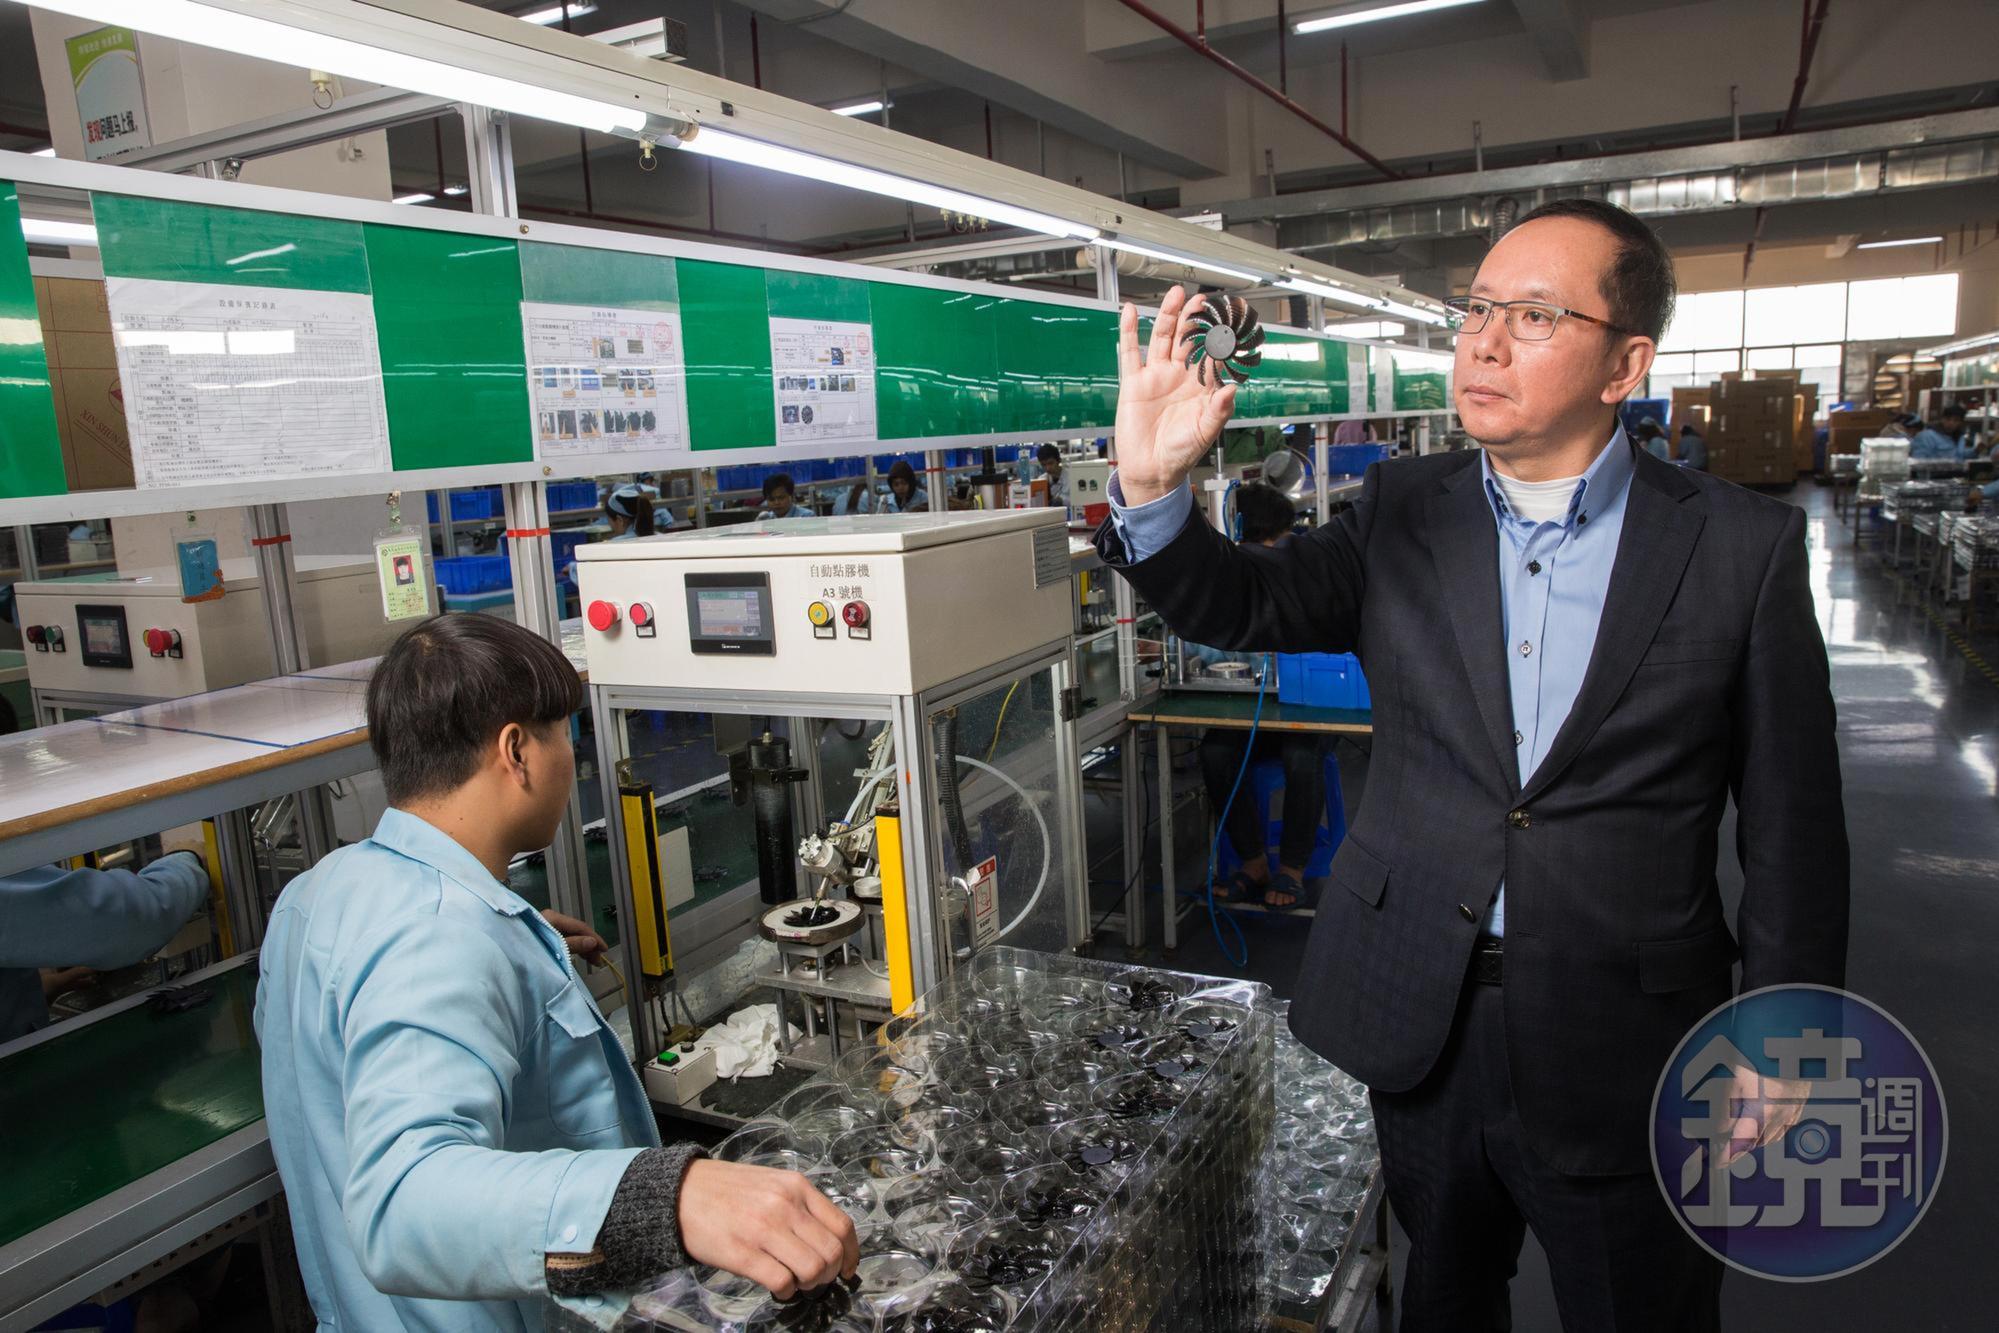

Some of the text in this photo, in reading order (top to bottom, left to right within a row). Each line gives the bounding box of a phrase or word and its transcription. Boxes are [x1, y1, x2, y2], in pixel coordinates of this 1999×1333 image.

[810, 563, 870, 578] 自動點膠機
[823, 588, 835, 598] A3
